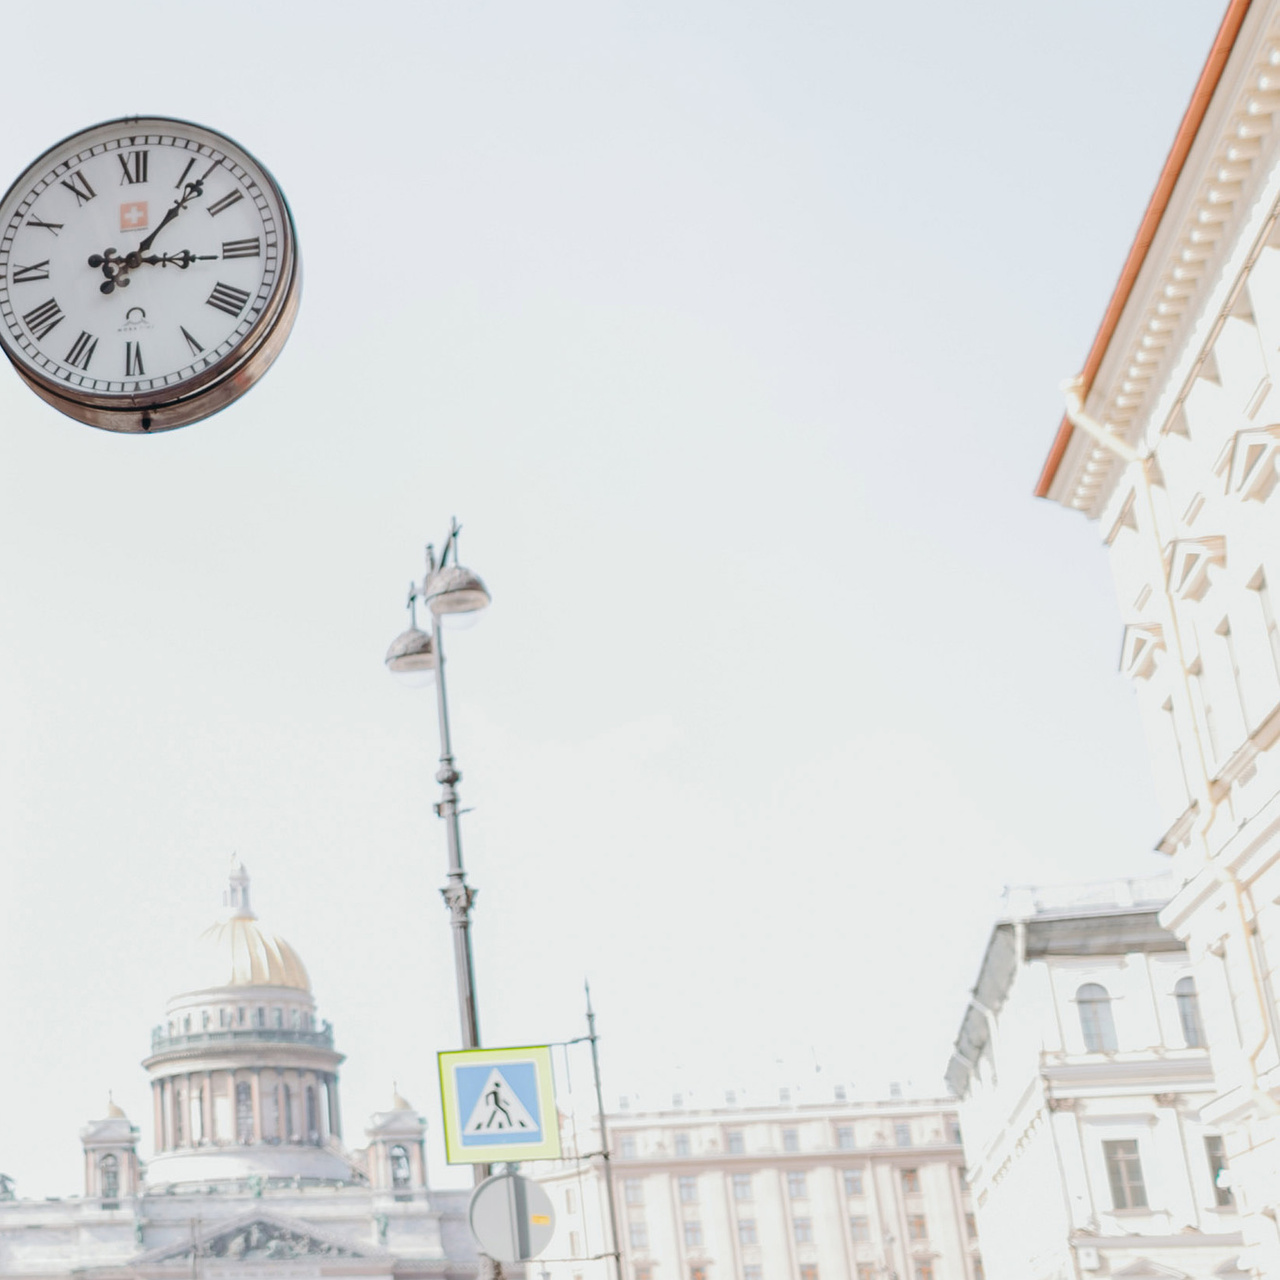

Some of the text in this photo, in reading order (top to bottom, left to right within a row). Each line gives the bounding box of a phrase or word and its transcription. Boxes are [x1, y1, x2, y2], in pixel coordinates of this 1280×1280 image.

[117, 150, 150, 186] XII
[61, 170, 97, 207] XI
[207, 188, 244, 217] II
[26, 213, 64, 236] X
[222, 237, 260, 260] III
[13, 259, 50, 284] IX
[22, 297, 66, 341] VIII
[64, 330, 99, 371] VII
[180, 325, 205, 357] V
[125, 341, 146, 377] VI
